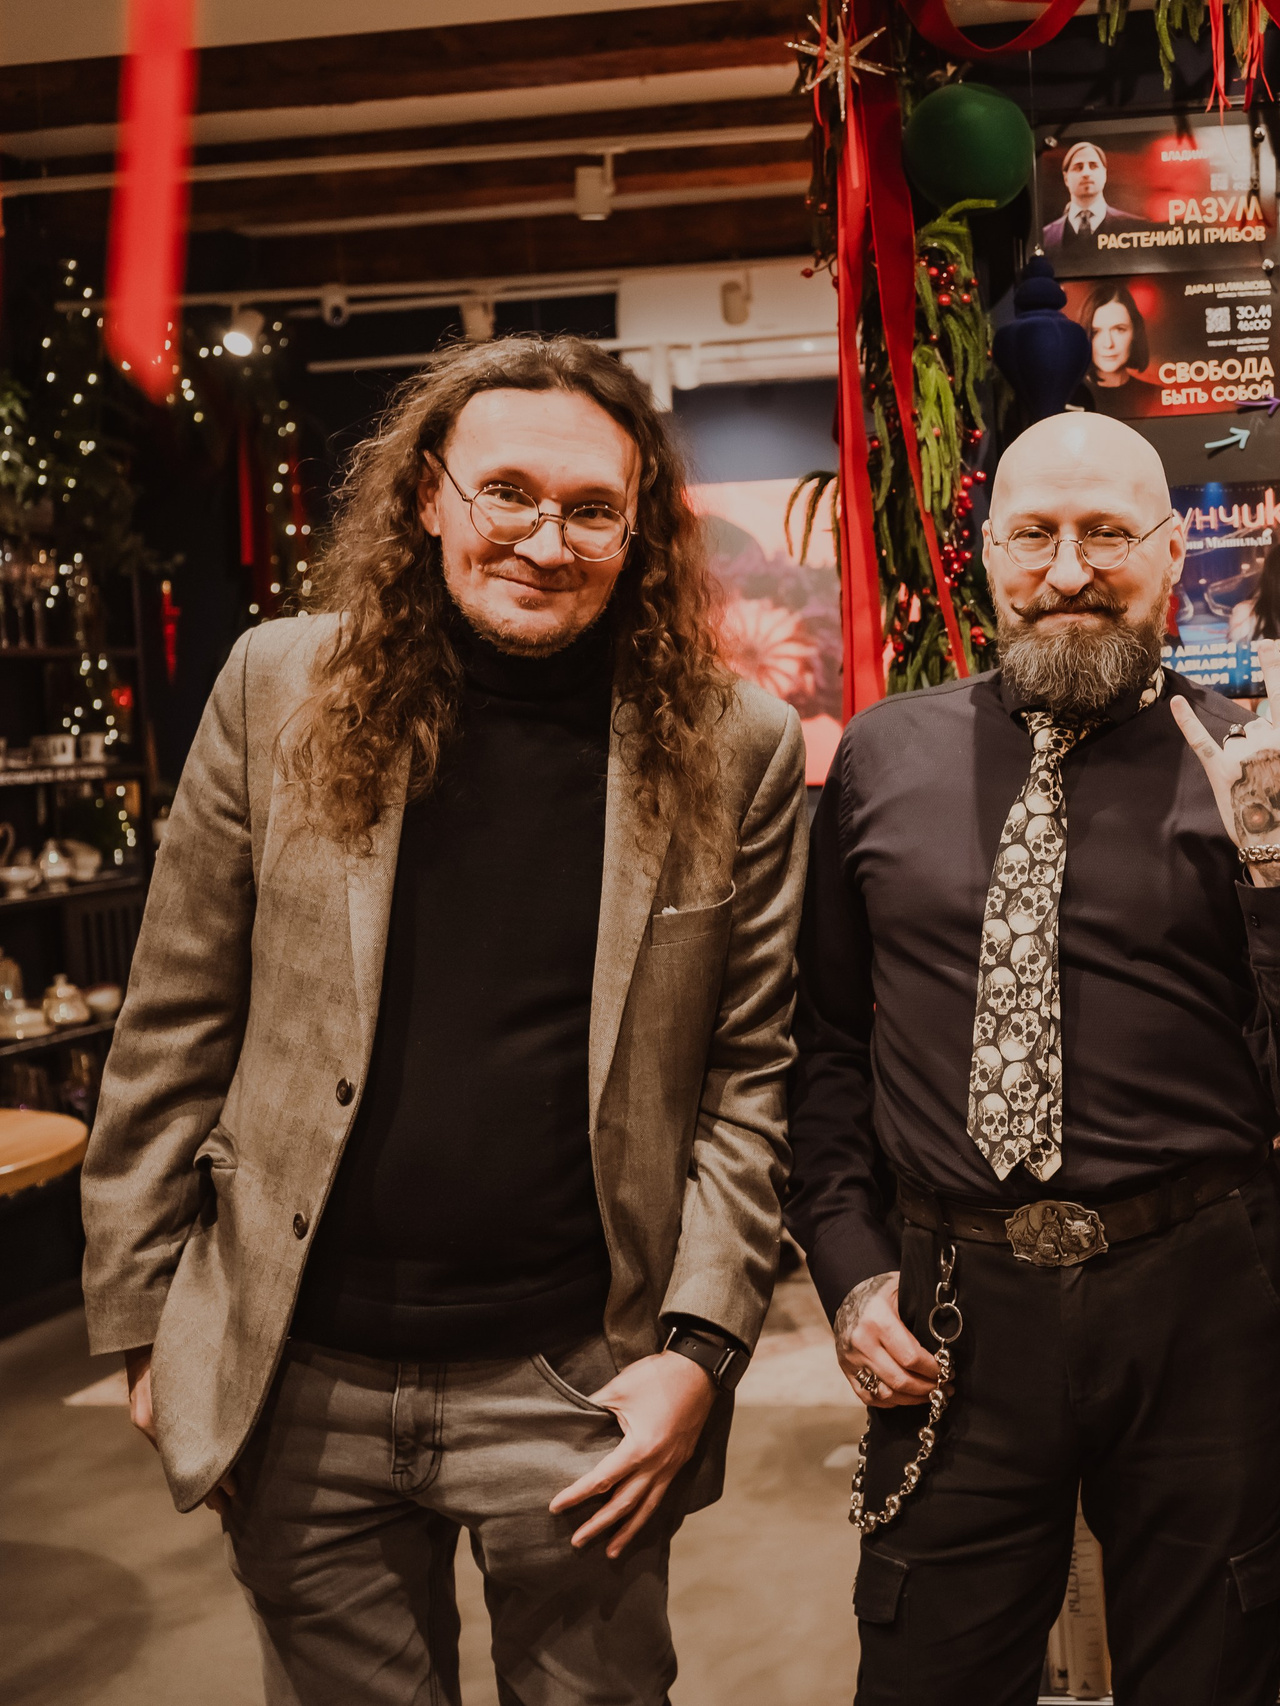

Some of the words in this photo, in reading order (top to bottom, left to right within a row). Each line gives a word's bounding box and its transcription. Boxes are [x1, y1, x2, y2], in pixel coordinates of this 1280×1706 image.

[1168, 195, 1263, 225] РАЗУМ
[1098, 226, 1184, 250] РАСТЕНИЙ
[1187, 229, 1200, 245] И
[1203, 225, 1267, 244] ГРИБОВ
[1158, 356, 1275, 384] СВОБОДА
[1161, 387, 1209, 406] БЫТЬ
[1211, 380, 1275, 403] СОБОЙ
